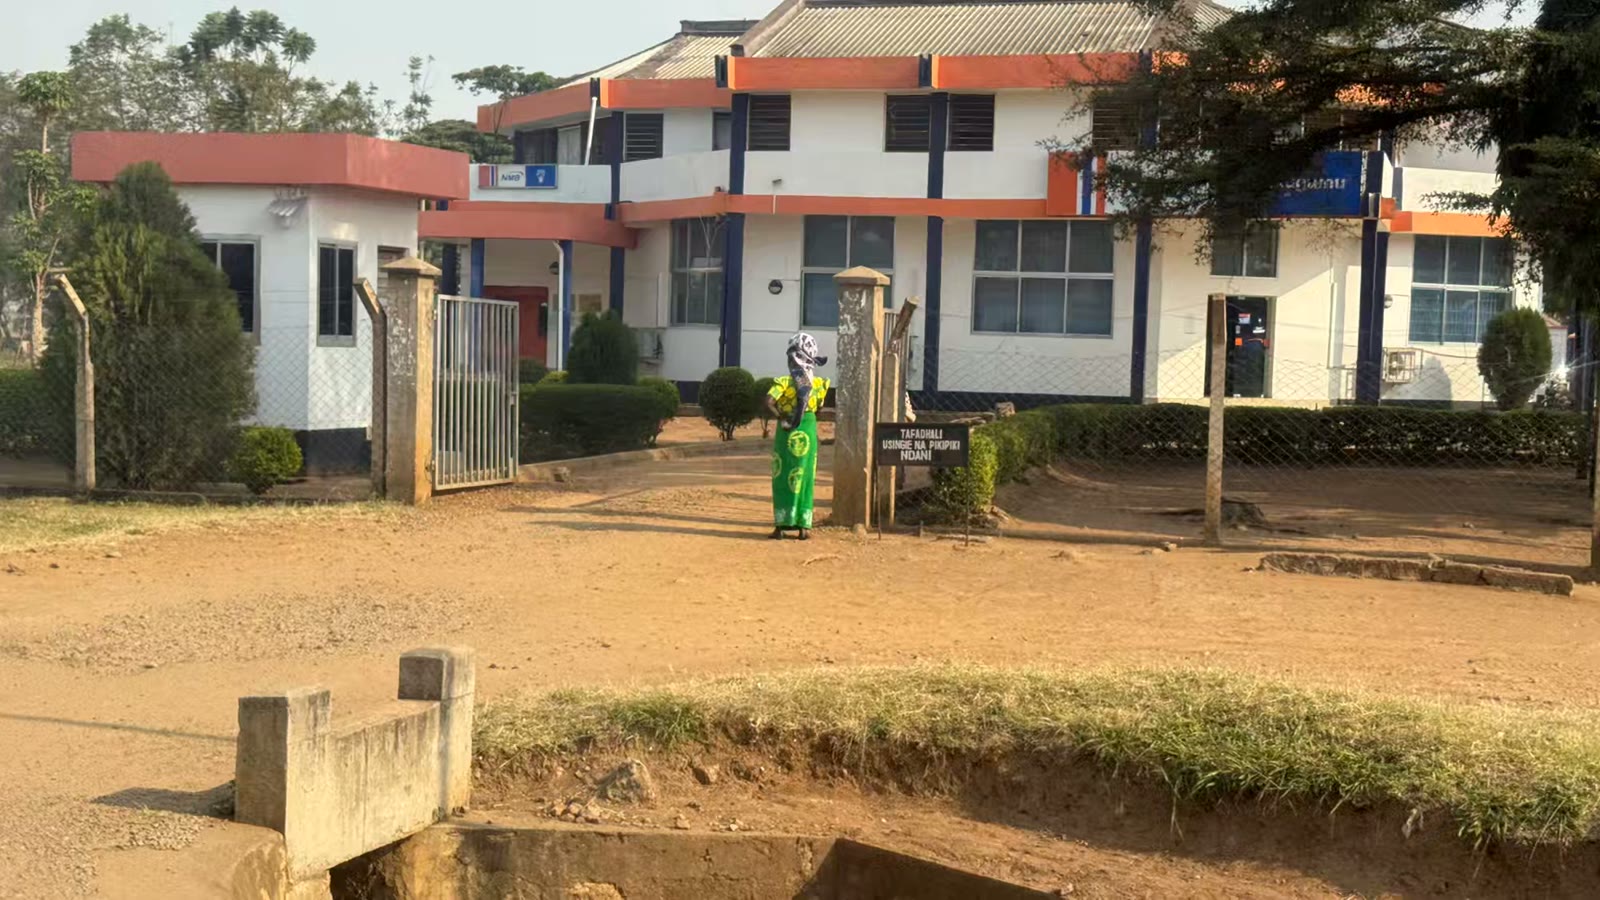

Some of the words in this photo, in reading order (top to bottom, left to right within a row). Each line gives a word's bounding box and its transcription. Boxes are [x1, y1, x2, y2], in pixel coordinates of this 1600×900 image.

[900, 428, 943, 440] TAFADHALI
[882, 440, 913, 450] USINGIE
[914, 441, 927, 450] NA
[929, 440, 961, 450] PIKIPIKI
[900, 449, 932, 461] NDANI
